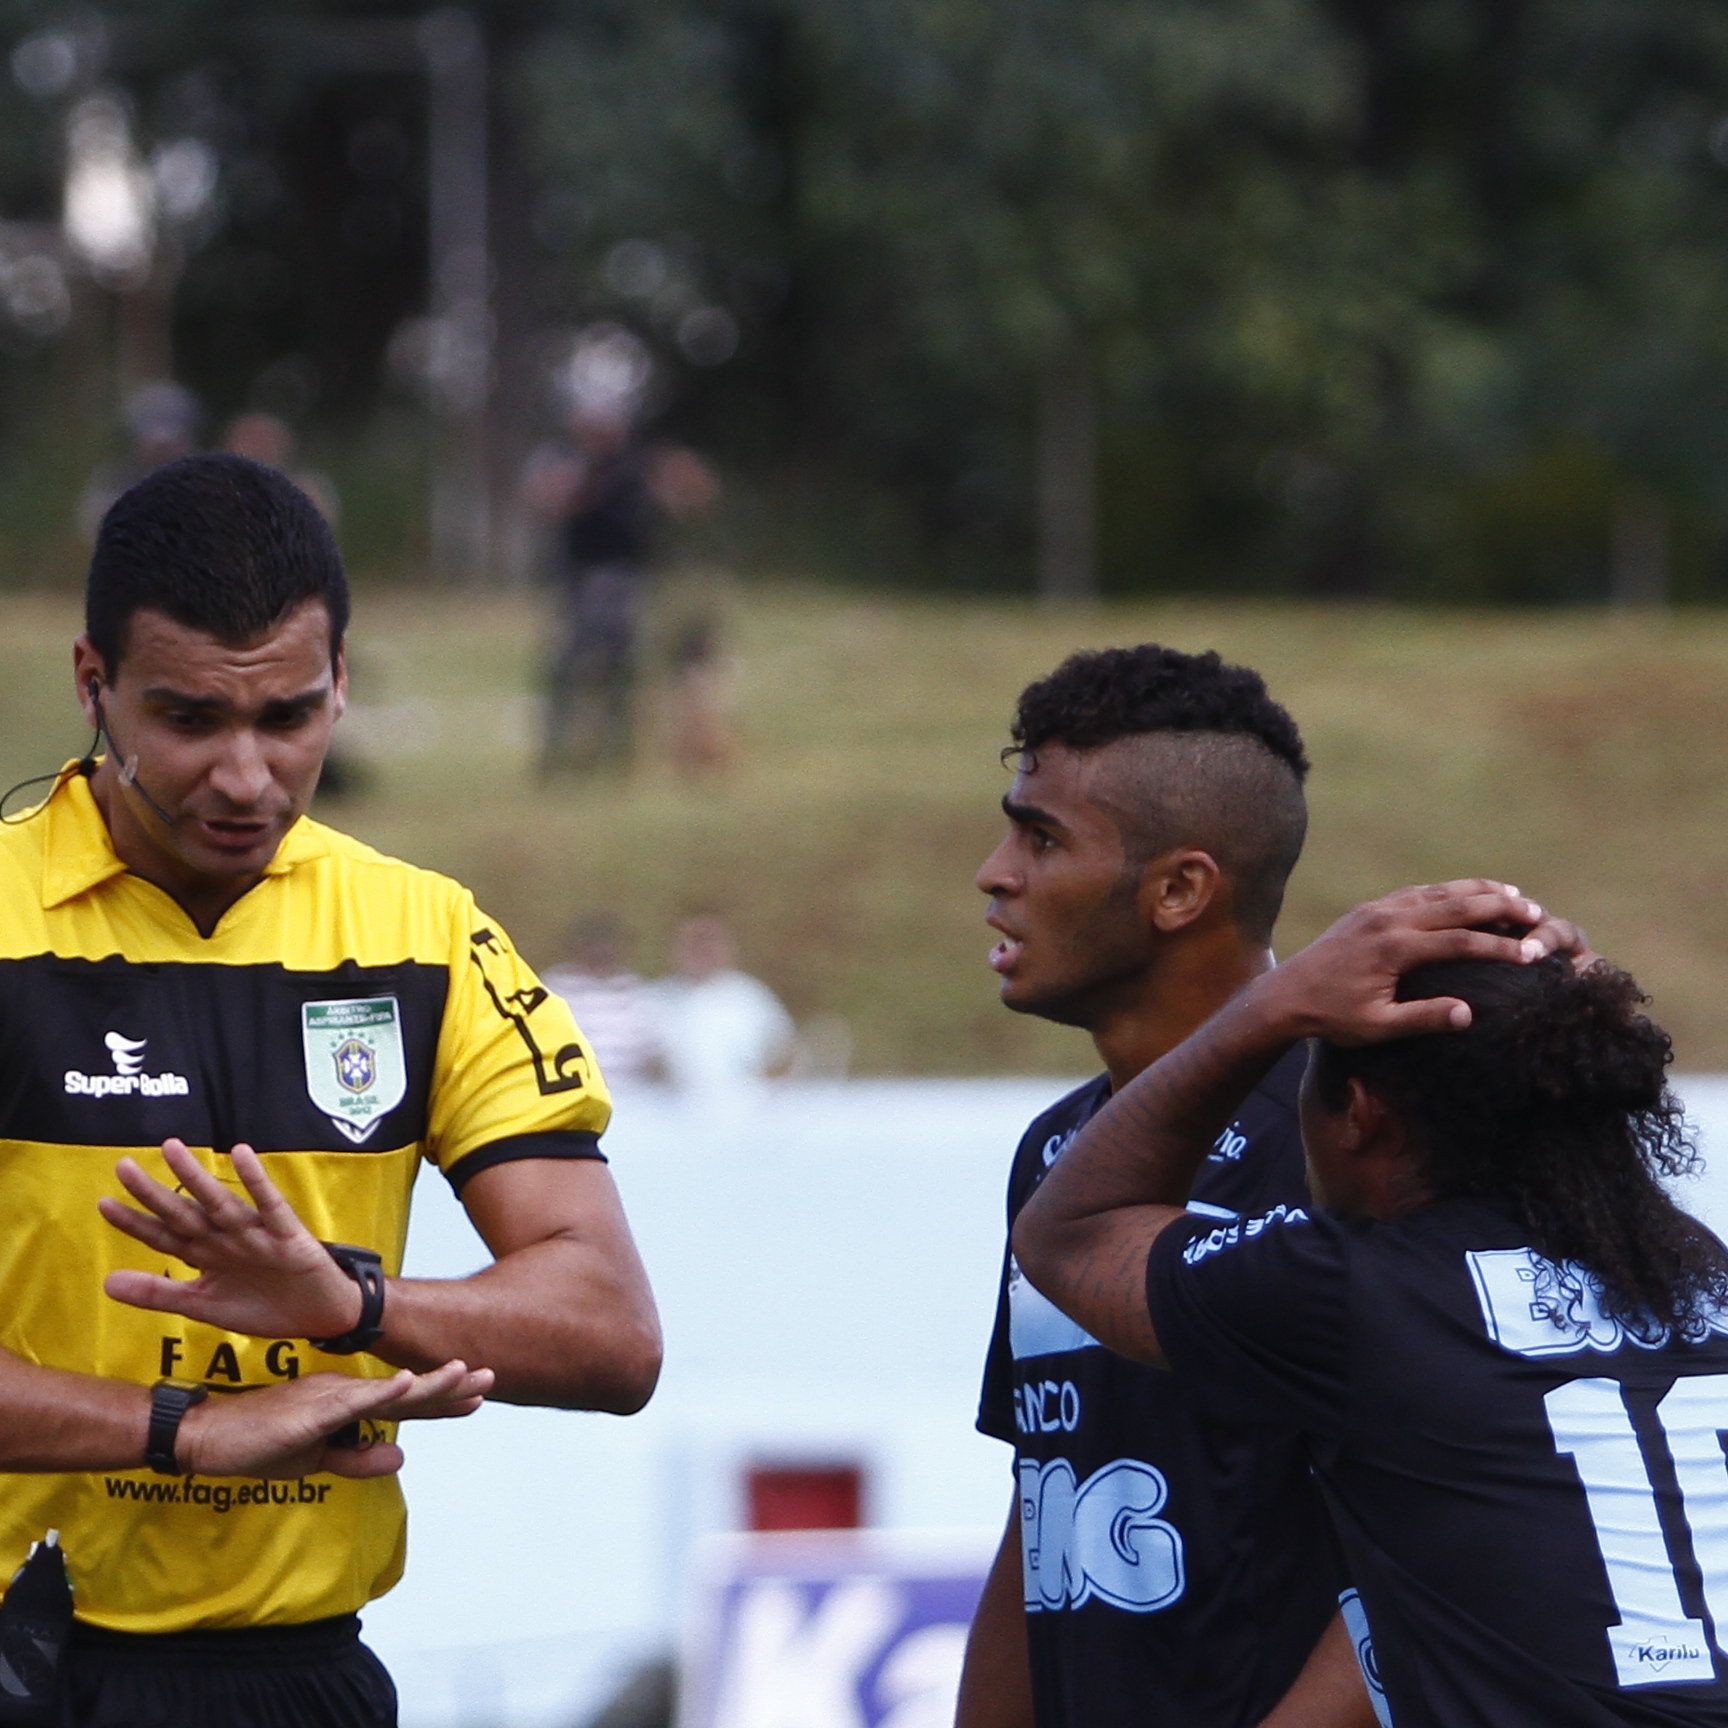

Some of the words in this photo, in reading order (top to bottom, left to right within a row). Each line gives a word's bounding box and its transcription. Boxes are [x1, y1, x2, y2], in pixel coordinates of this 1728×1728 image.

[470, 926, 591, 1088] FAG
[159, 1336, 300, 1382] FAG
[1013, 1379, 1082, 1434] ANCO
[104, 1474, 332, 1514] www.fag.edu.br
[1638, 1643, 1700, 1662] Karilu
